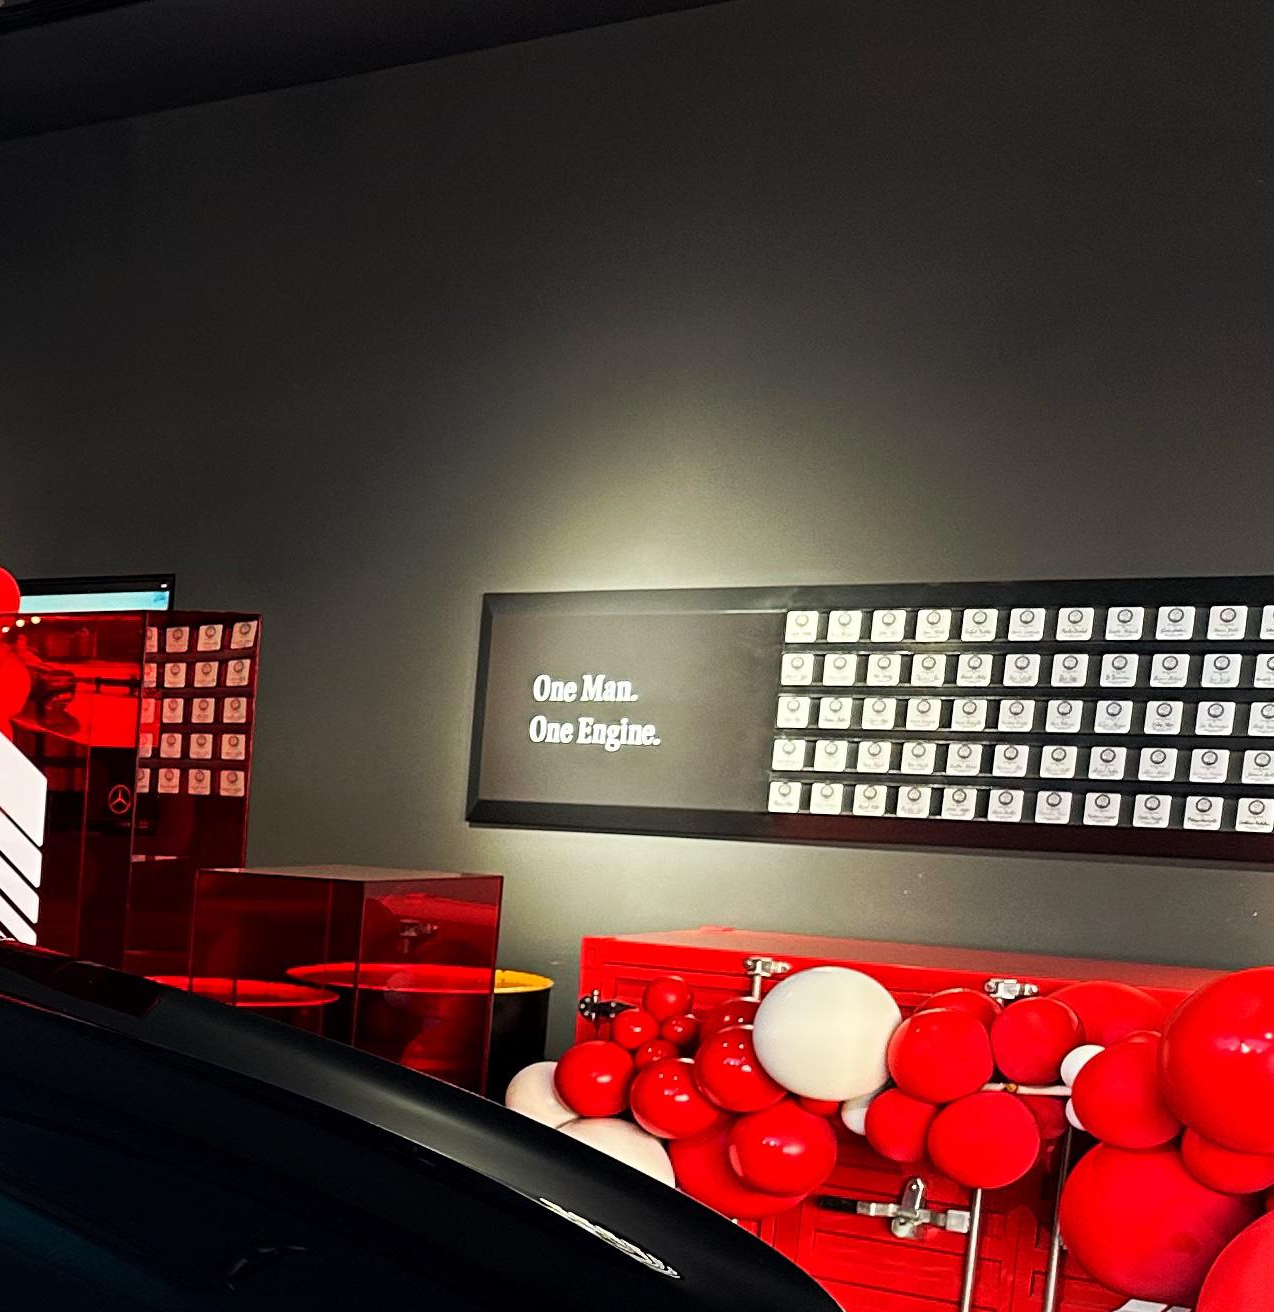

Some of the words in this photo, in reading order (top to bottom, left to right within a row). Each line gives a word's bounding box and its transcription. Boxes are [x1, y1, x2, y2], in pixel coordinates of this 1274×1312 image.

[533, 674, 578, 702] One
[580, 674, 639, 702] Man.
[529, 715, 574, 744] One
[576, 716, 661, 752] Engine.
